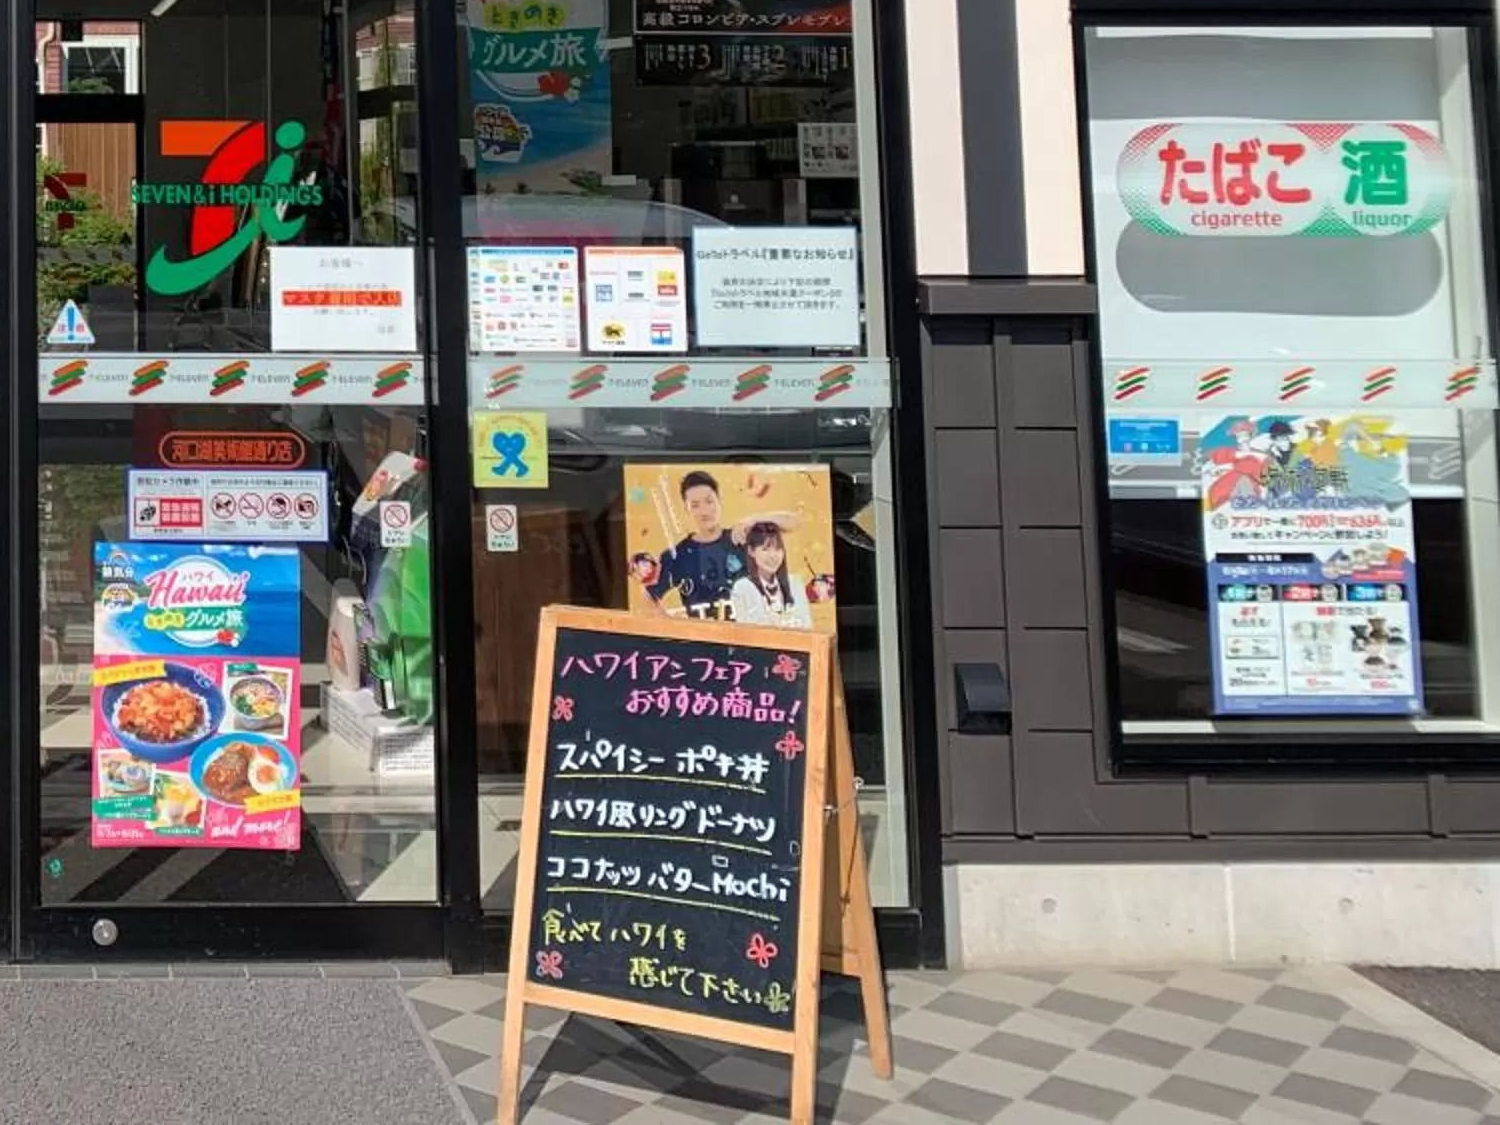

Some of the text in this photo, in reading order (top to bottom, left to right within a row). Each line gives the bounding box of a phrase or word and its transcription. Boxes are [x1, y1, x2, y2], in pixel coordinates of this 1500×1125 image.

[483, 32, 588, 68] グルメ旅
[1158, 138, 1409, 207] たばこ 酒
[131, 184, 192, 204] SEVEN
[220, 184, 323, 206] HOLDINGS
[1190, 209, 1413, 230] cigarette liquor
[146, 571, 250, 606] Hawaii
